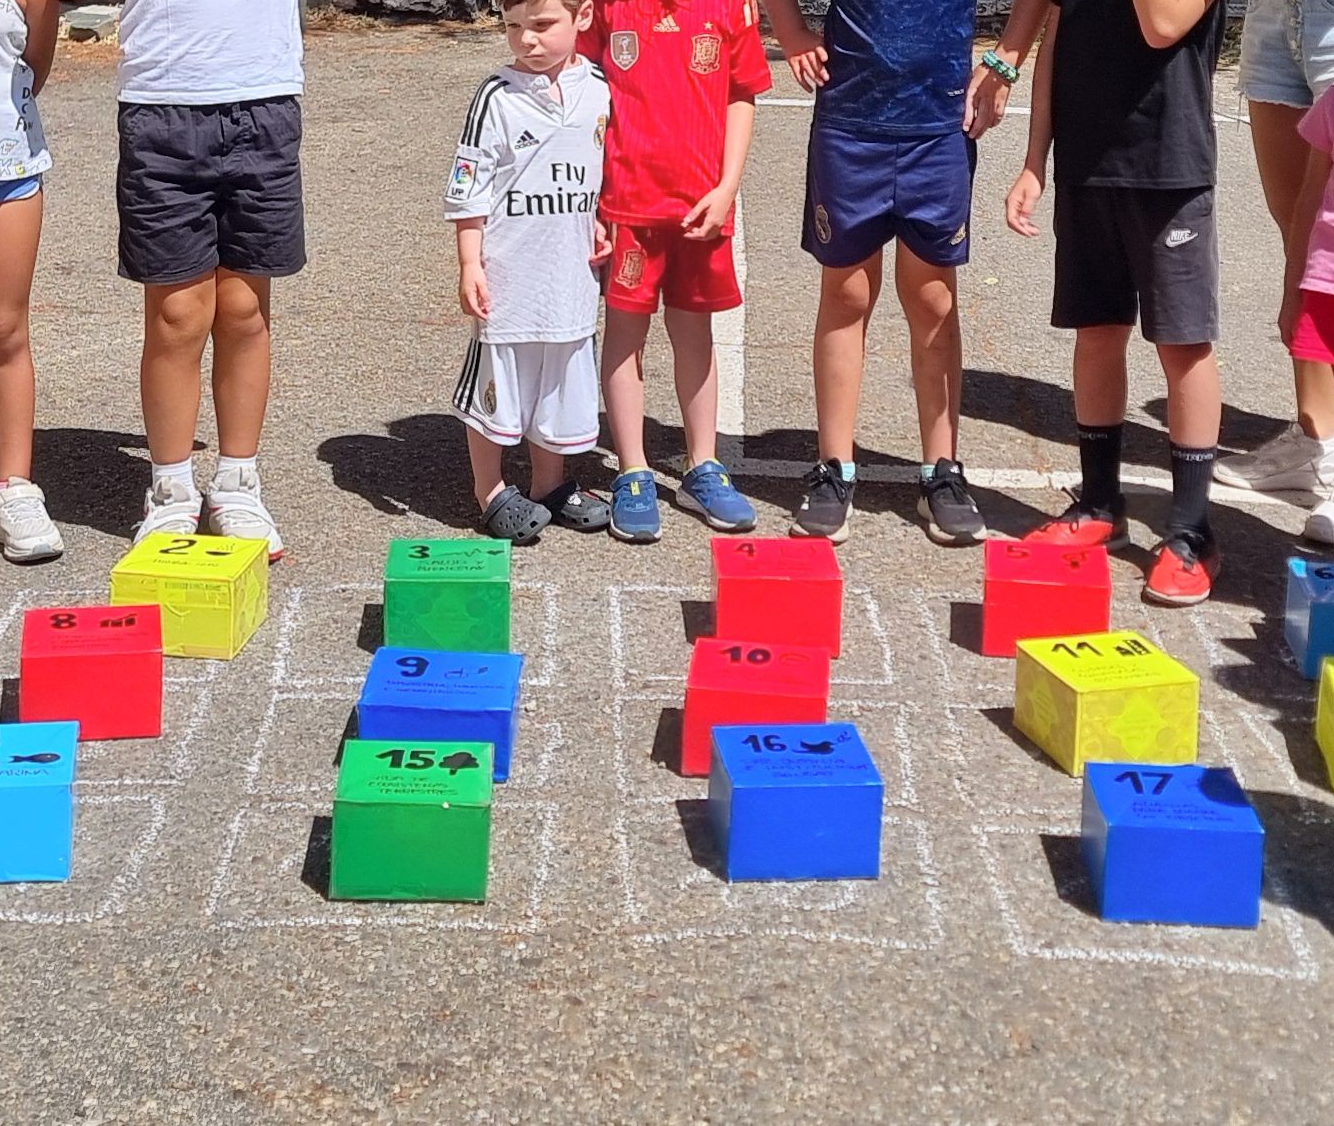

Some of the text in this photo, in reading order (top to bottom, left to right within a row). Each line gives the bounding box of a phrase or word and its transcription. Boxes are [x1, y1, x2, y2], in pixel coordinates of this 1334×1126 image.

[551, 163, 586, 185] Fly
[506, 187, 601, 217] Emirat
[159, 539, 198, 555] 2
[408, 545, 430, 559] 3
[49, 613, 78, 629] 8
[718, 645, 772, 665] 10
[395, 656, 430, 678] 9
[741, 734, 788, 754] 16
[375, 749, 436, 770] 15
[1114, 771, 1173, 795] 17
